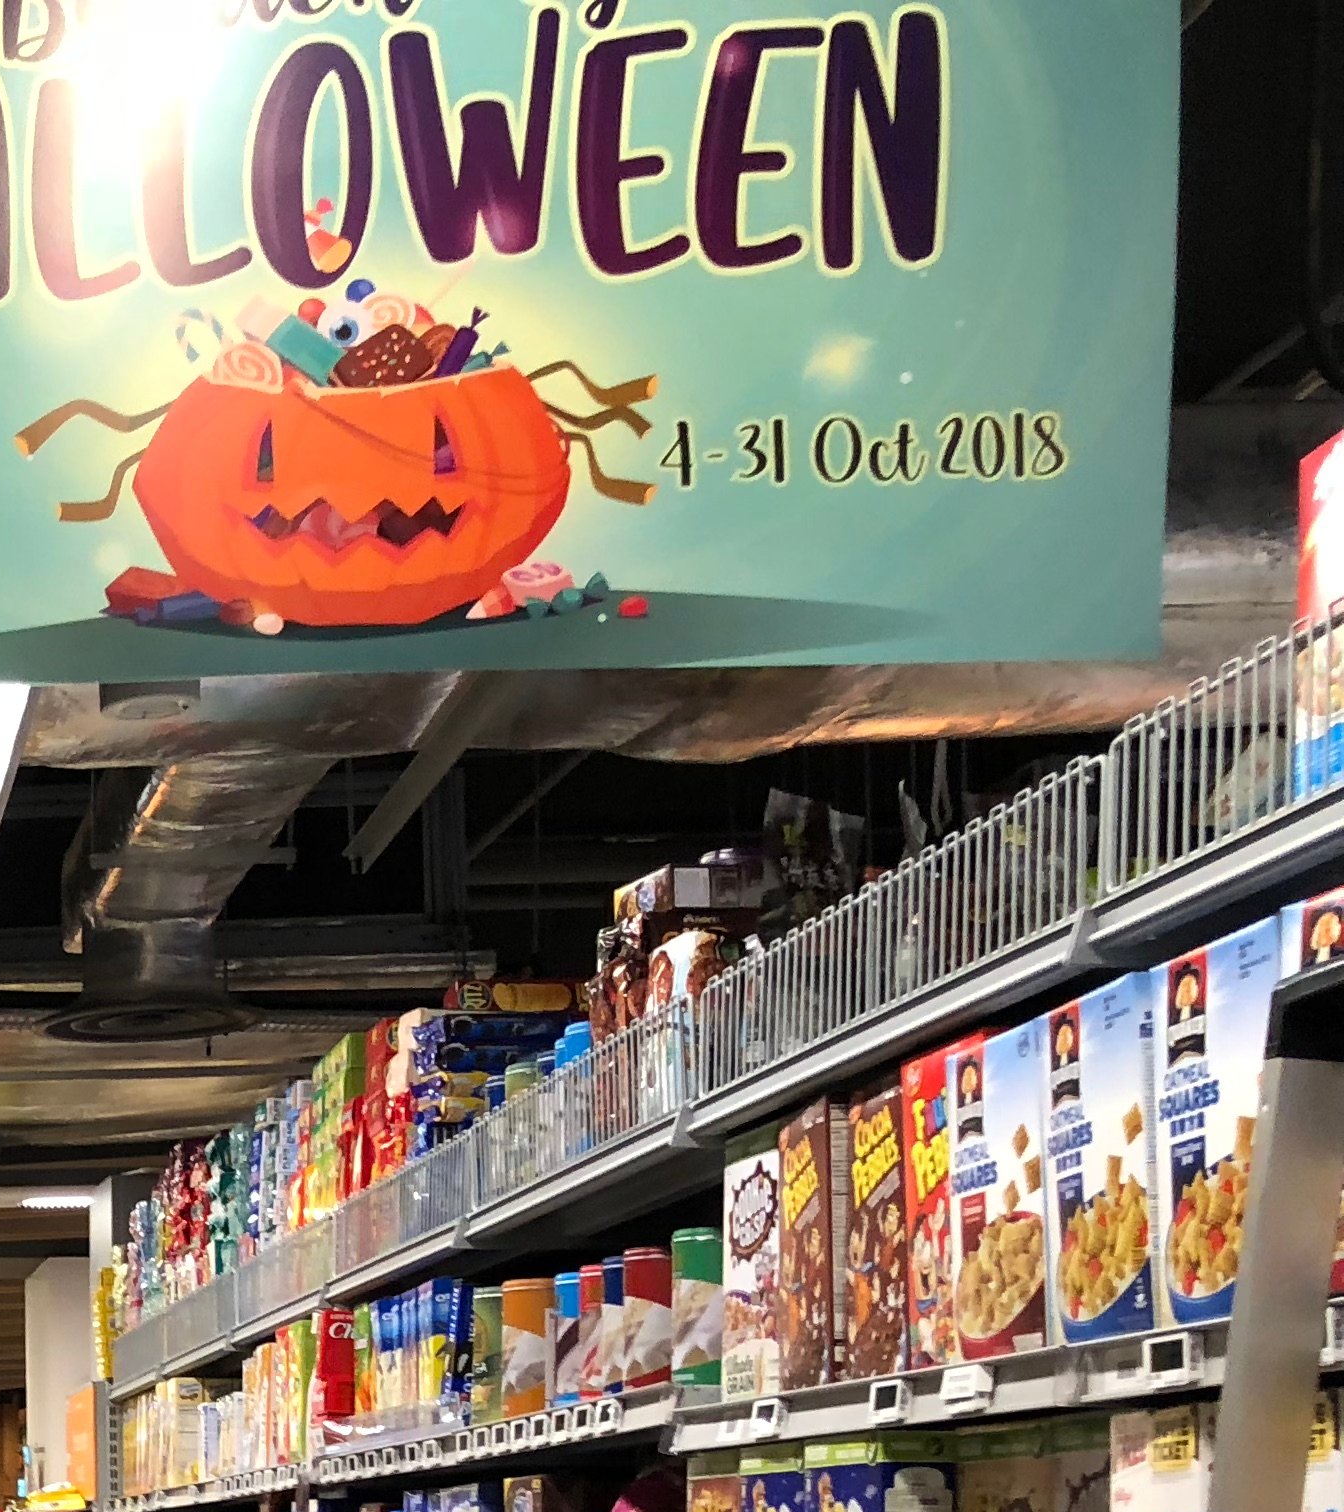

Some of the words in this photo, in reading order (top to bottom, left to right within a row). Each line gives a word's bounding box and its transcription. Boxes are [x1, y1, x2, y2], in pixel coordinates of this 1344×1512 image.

[658, 418, 785, 488] 4-31
[815, 410, 924, 481] Oct
[938, 408, 1066, 479] 2018
[853, 1104, 892, 1159] COCOA
[1159, 1079, 1220, 1122] SQUARES
[851, 1131, 902, 1209] PEBBLES
